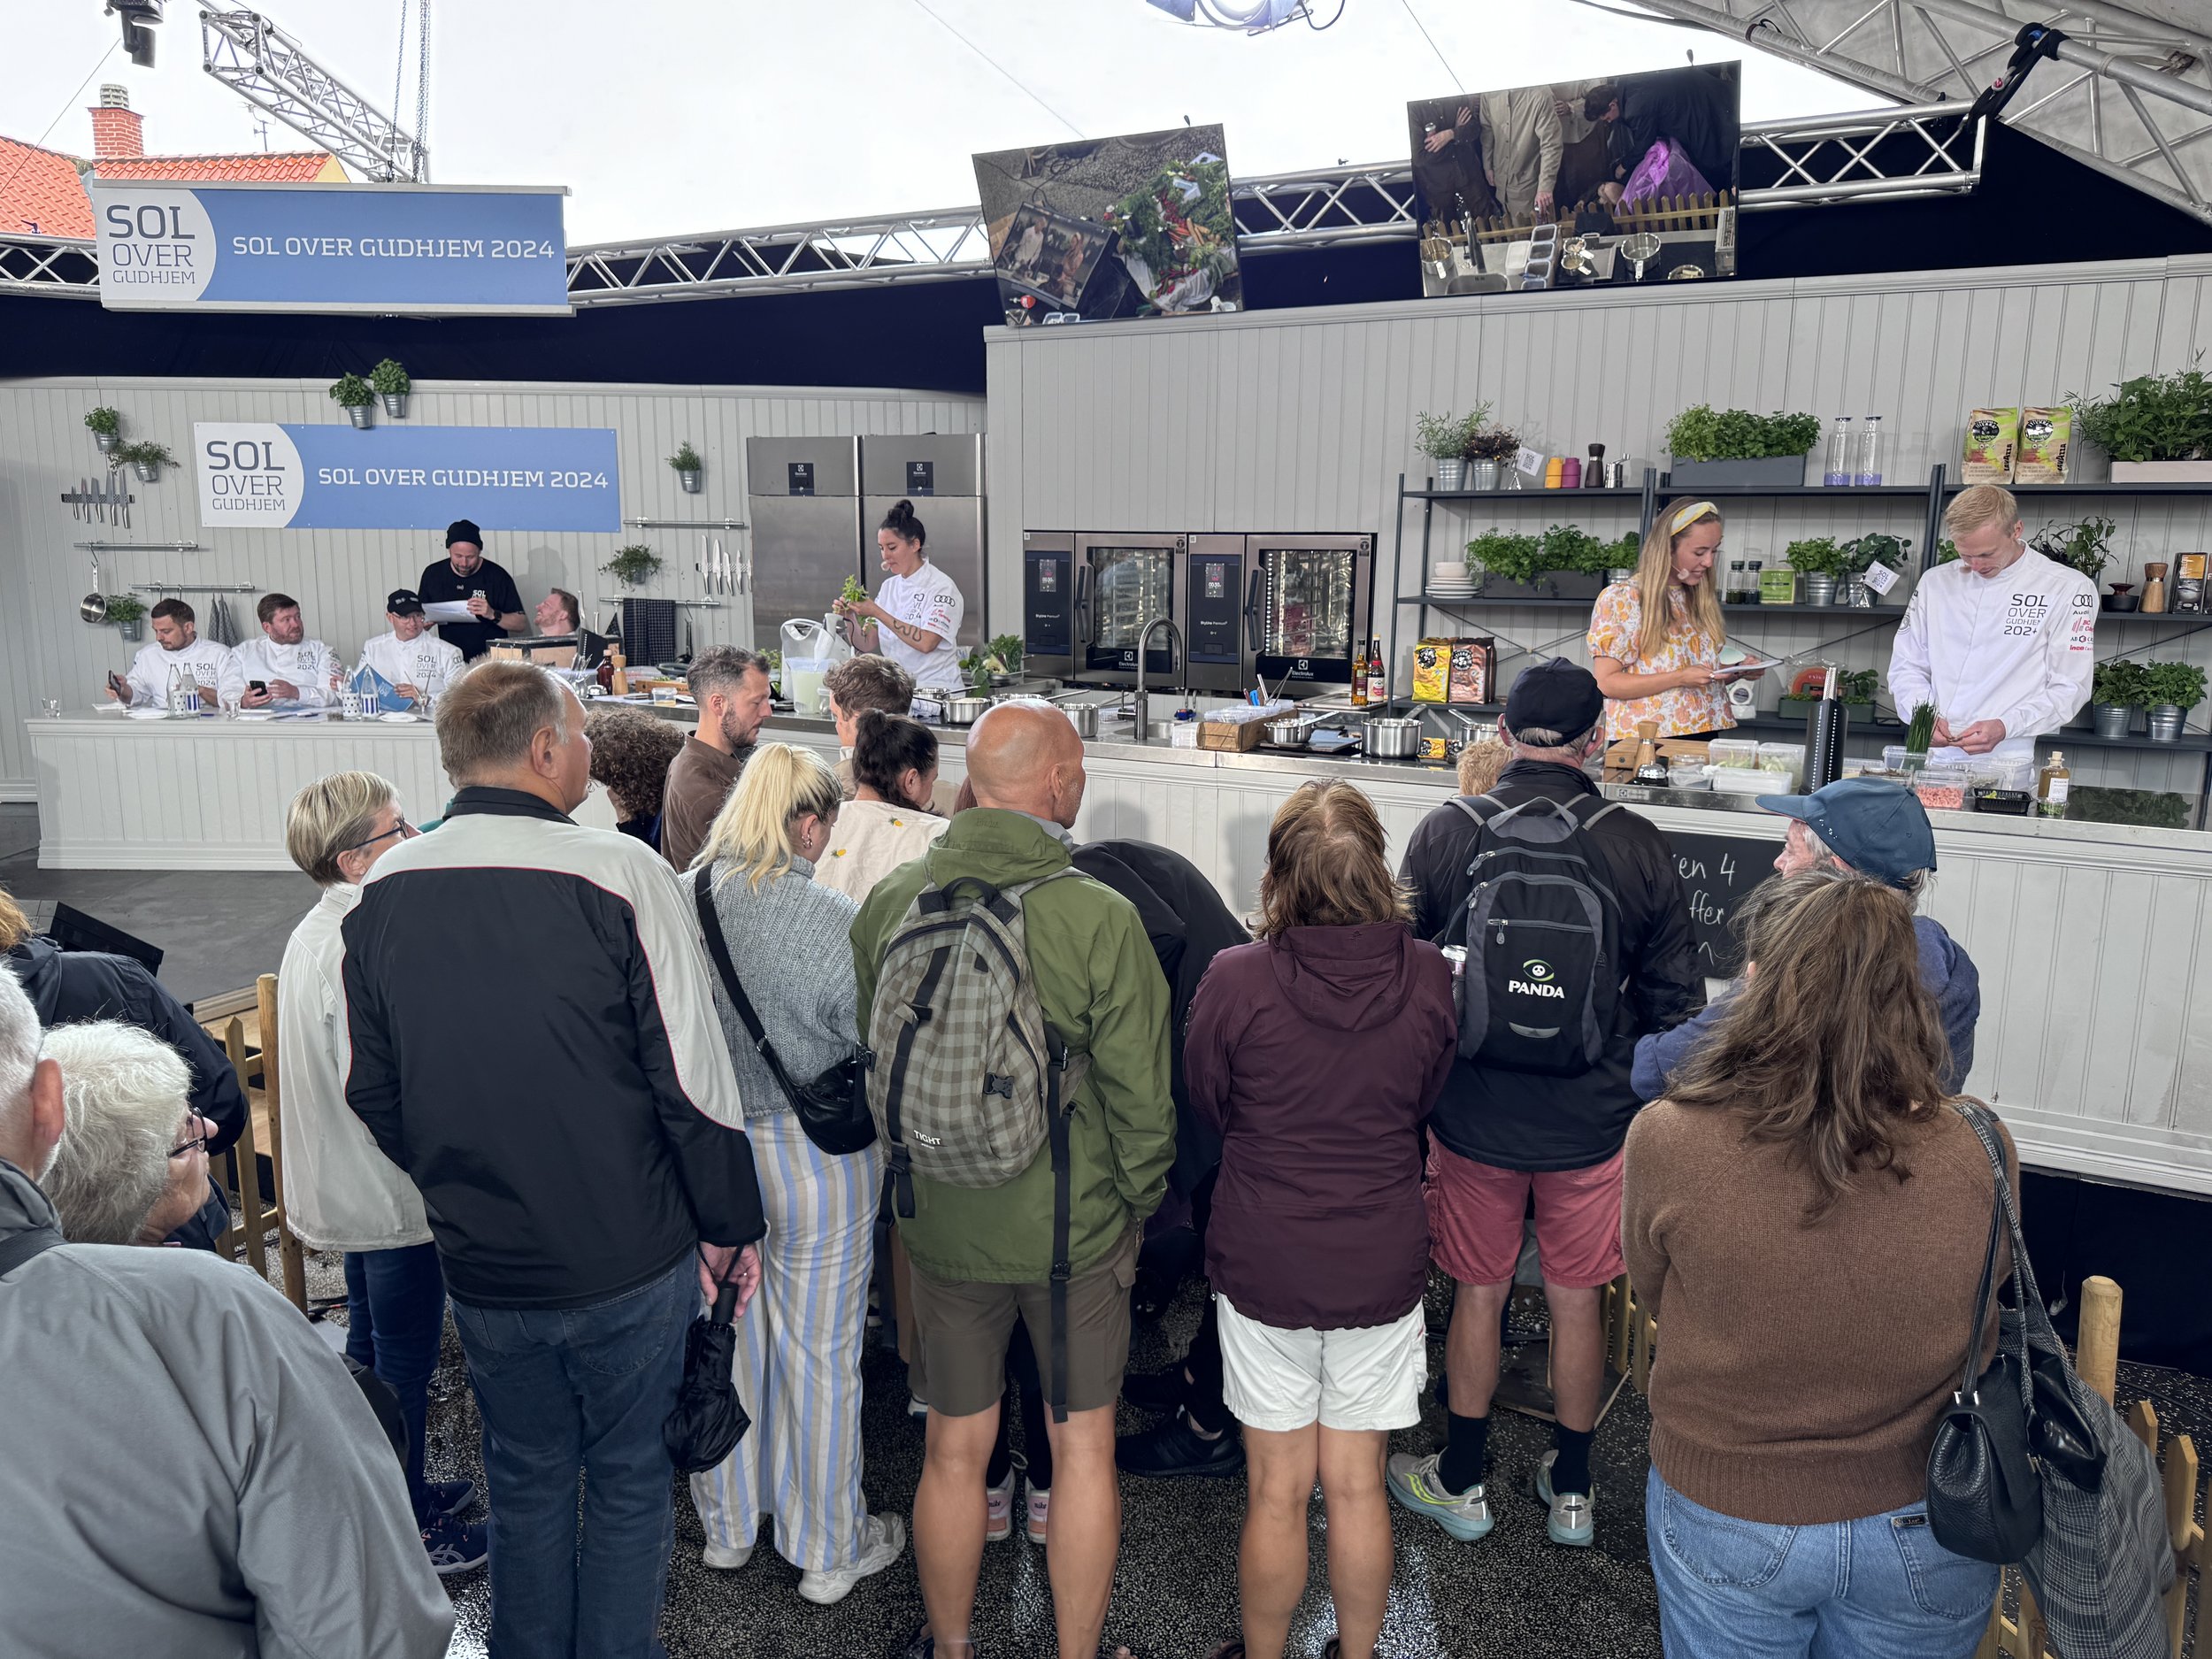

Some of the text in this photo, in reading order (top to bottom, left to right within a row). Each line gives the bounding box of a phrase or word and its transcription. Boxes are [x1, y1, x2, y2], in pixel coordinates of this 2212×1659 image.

[106, 205, 195, 240] SOL
[112, 243, 194, 268] OVER
[233, 236, 555, 259] SOL OVER GUDHJEM 2024
[112, 270, 196, 285] GUDHJEM
[206, 441, 285, 471] SOL
[211, 475, 282, 495] OVER
[319, 468, 609, 488] SOL OVER GUDHJEM 2024
[212, 498, 286, 511] GUDHJEM
[2011, 594, 2048, 607] SOL
[2008, 607, 2046, 618] OVER
[1508, 979, 1565, 999] PANDA
[913, 1129, 941, 1145] TIGHT
